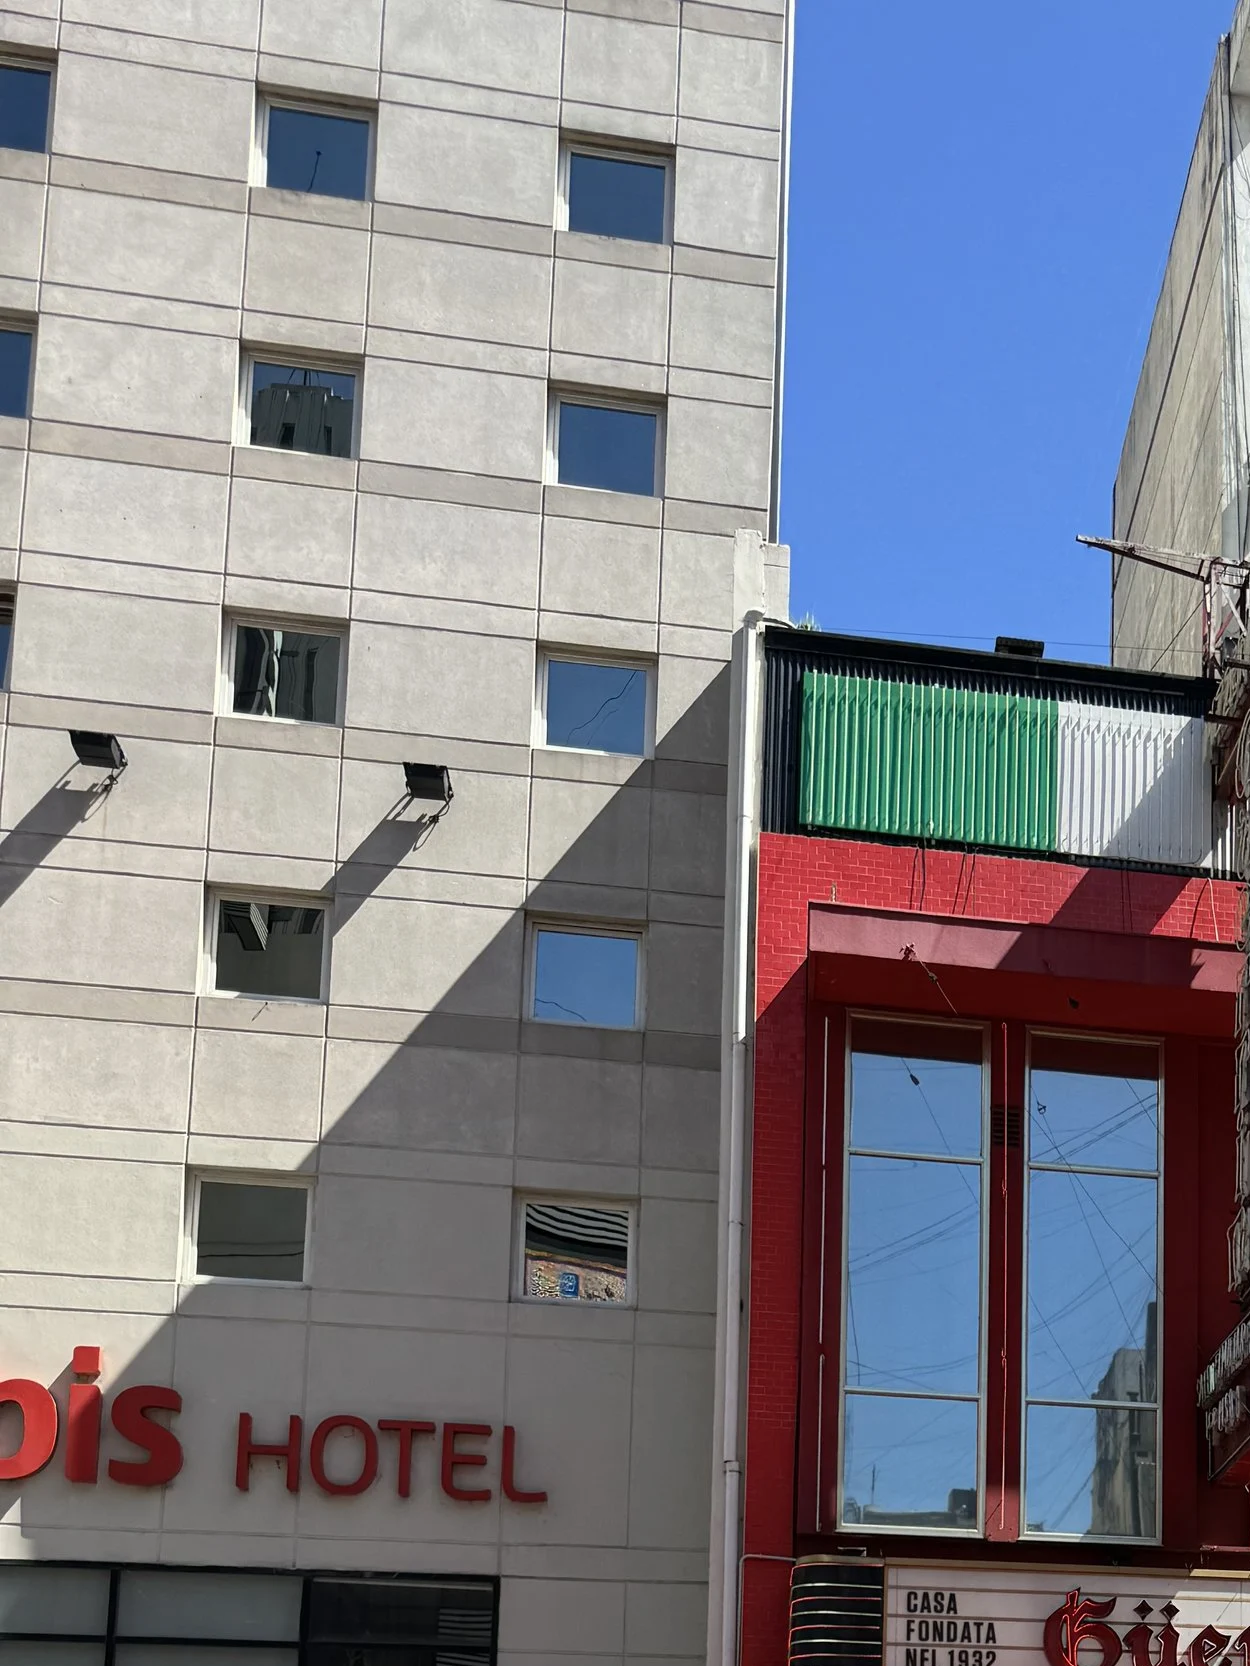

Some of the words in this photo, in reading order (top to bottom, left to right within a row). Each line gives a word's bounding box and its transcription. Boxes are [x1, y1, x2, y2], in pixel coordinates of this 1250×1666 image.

[235, 1411, 548, 1502] HOTEL
[906, 1591, 958, 1615] CASA
[906, 1619, 997, 1644] FONDATA
